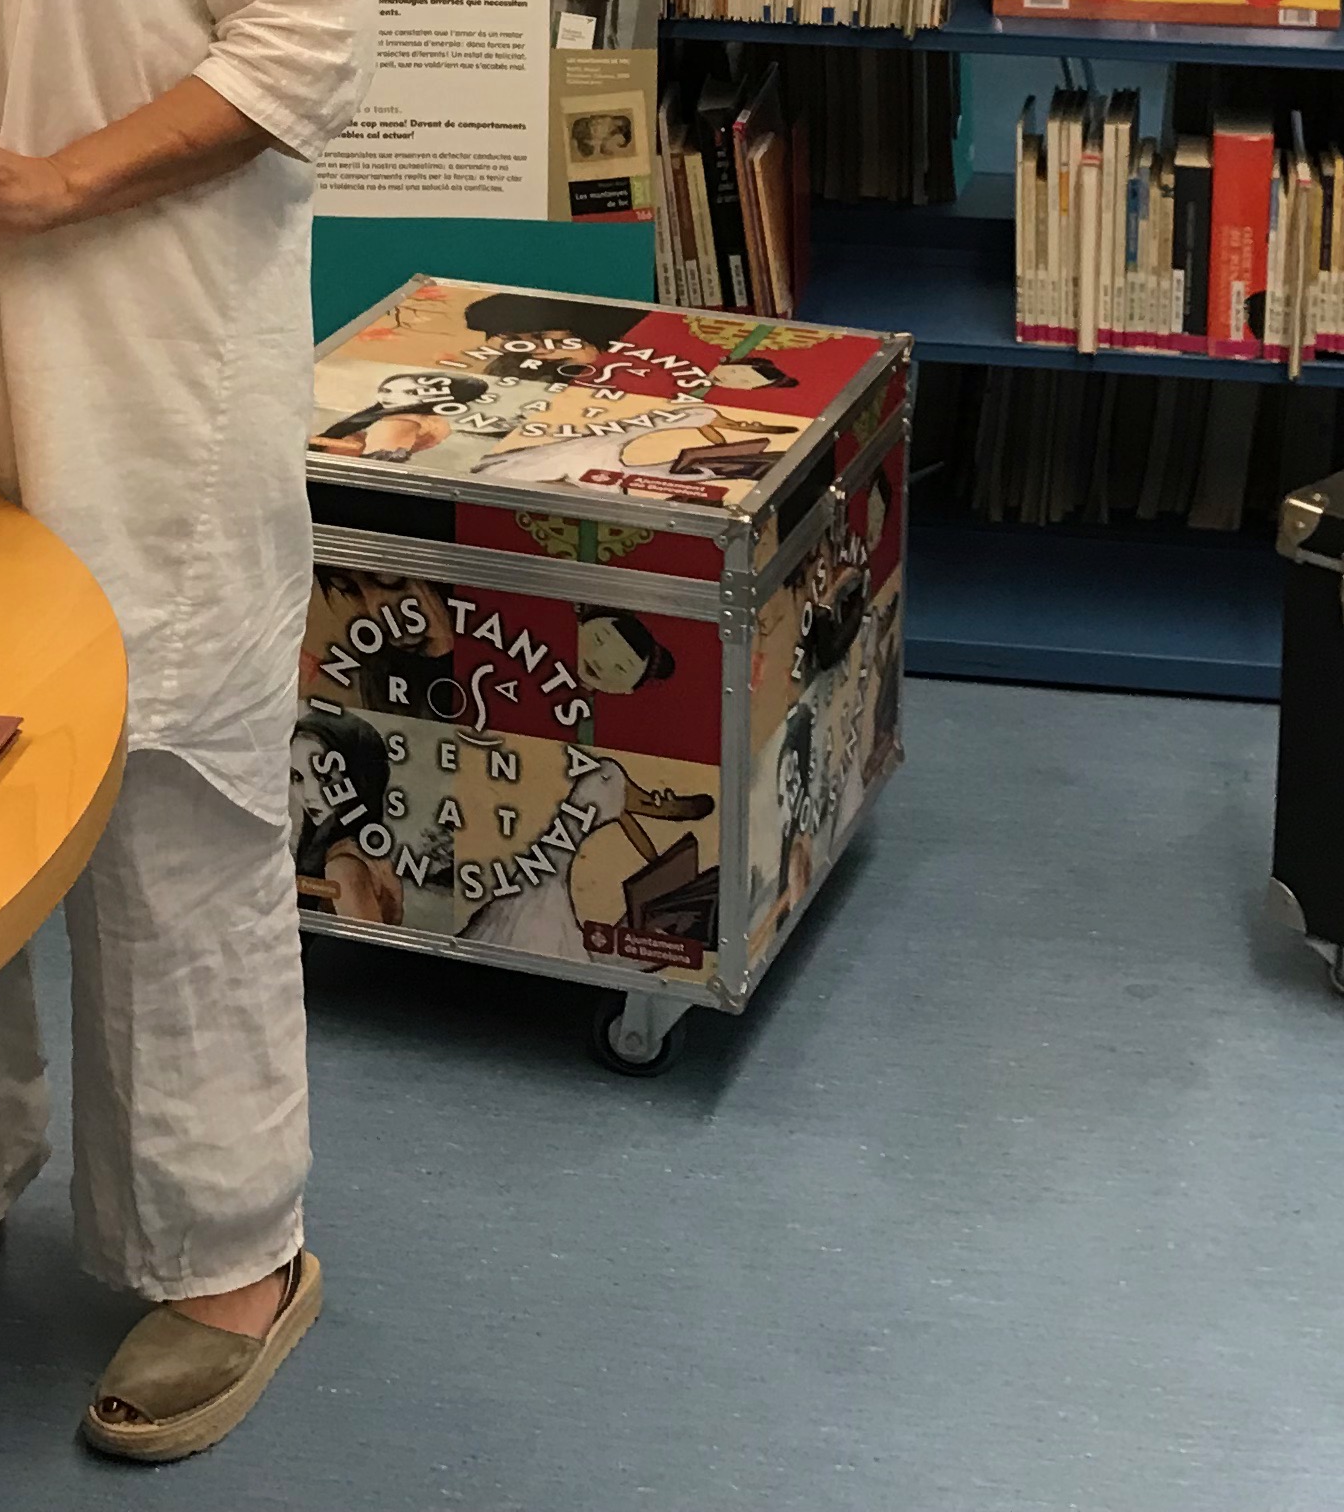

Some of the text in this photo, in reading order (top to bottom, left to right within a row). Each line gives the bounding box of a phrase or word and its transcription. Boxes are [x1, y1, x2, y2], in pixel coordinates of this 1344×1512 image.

[416, 338, 712, 437] NOIS TANTS TANTS NOIES
[319, 598, 426, 687] NOIS
[447, 598, 590, 726] TANTS
[567, 745, 600, 777] A
[312, 750, 430, 887] NOIES
[460, 802, 596, 900] TANTS
